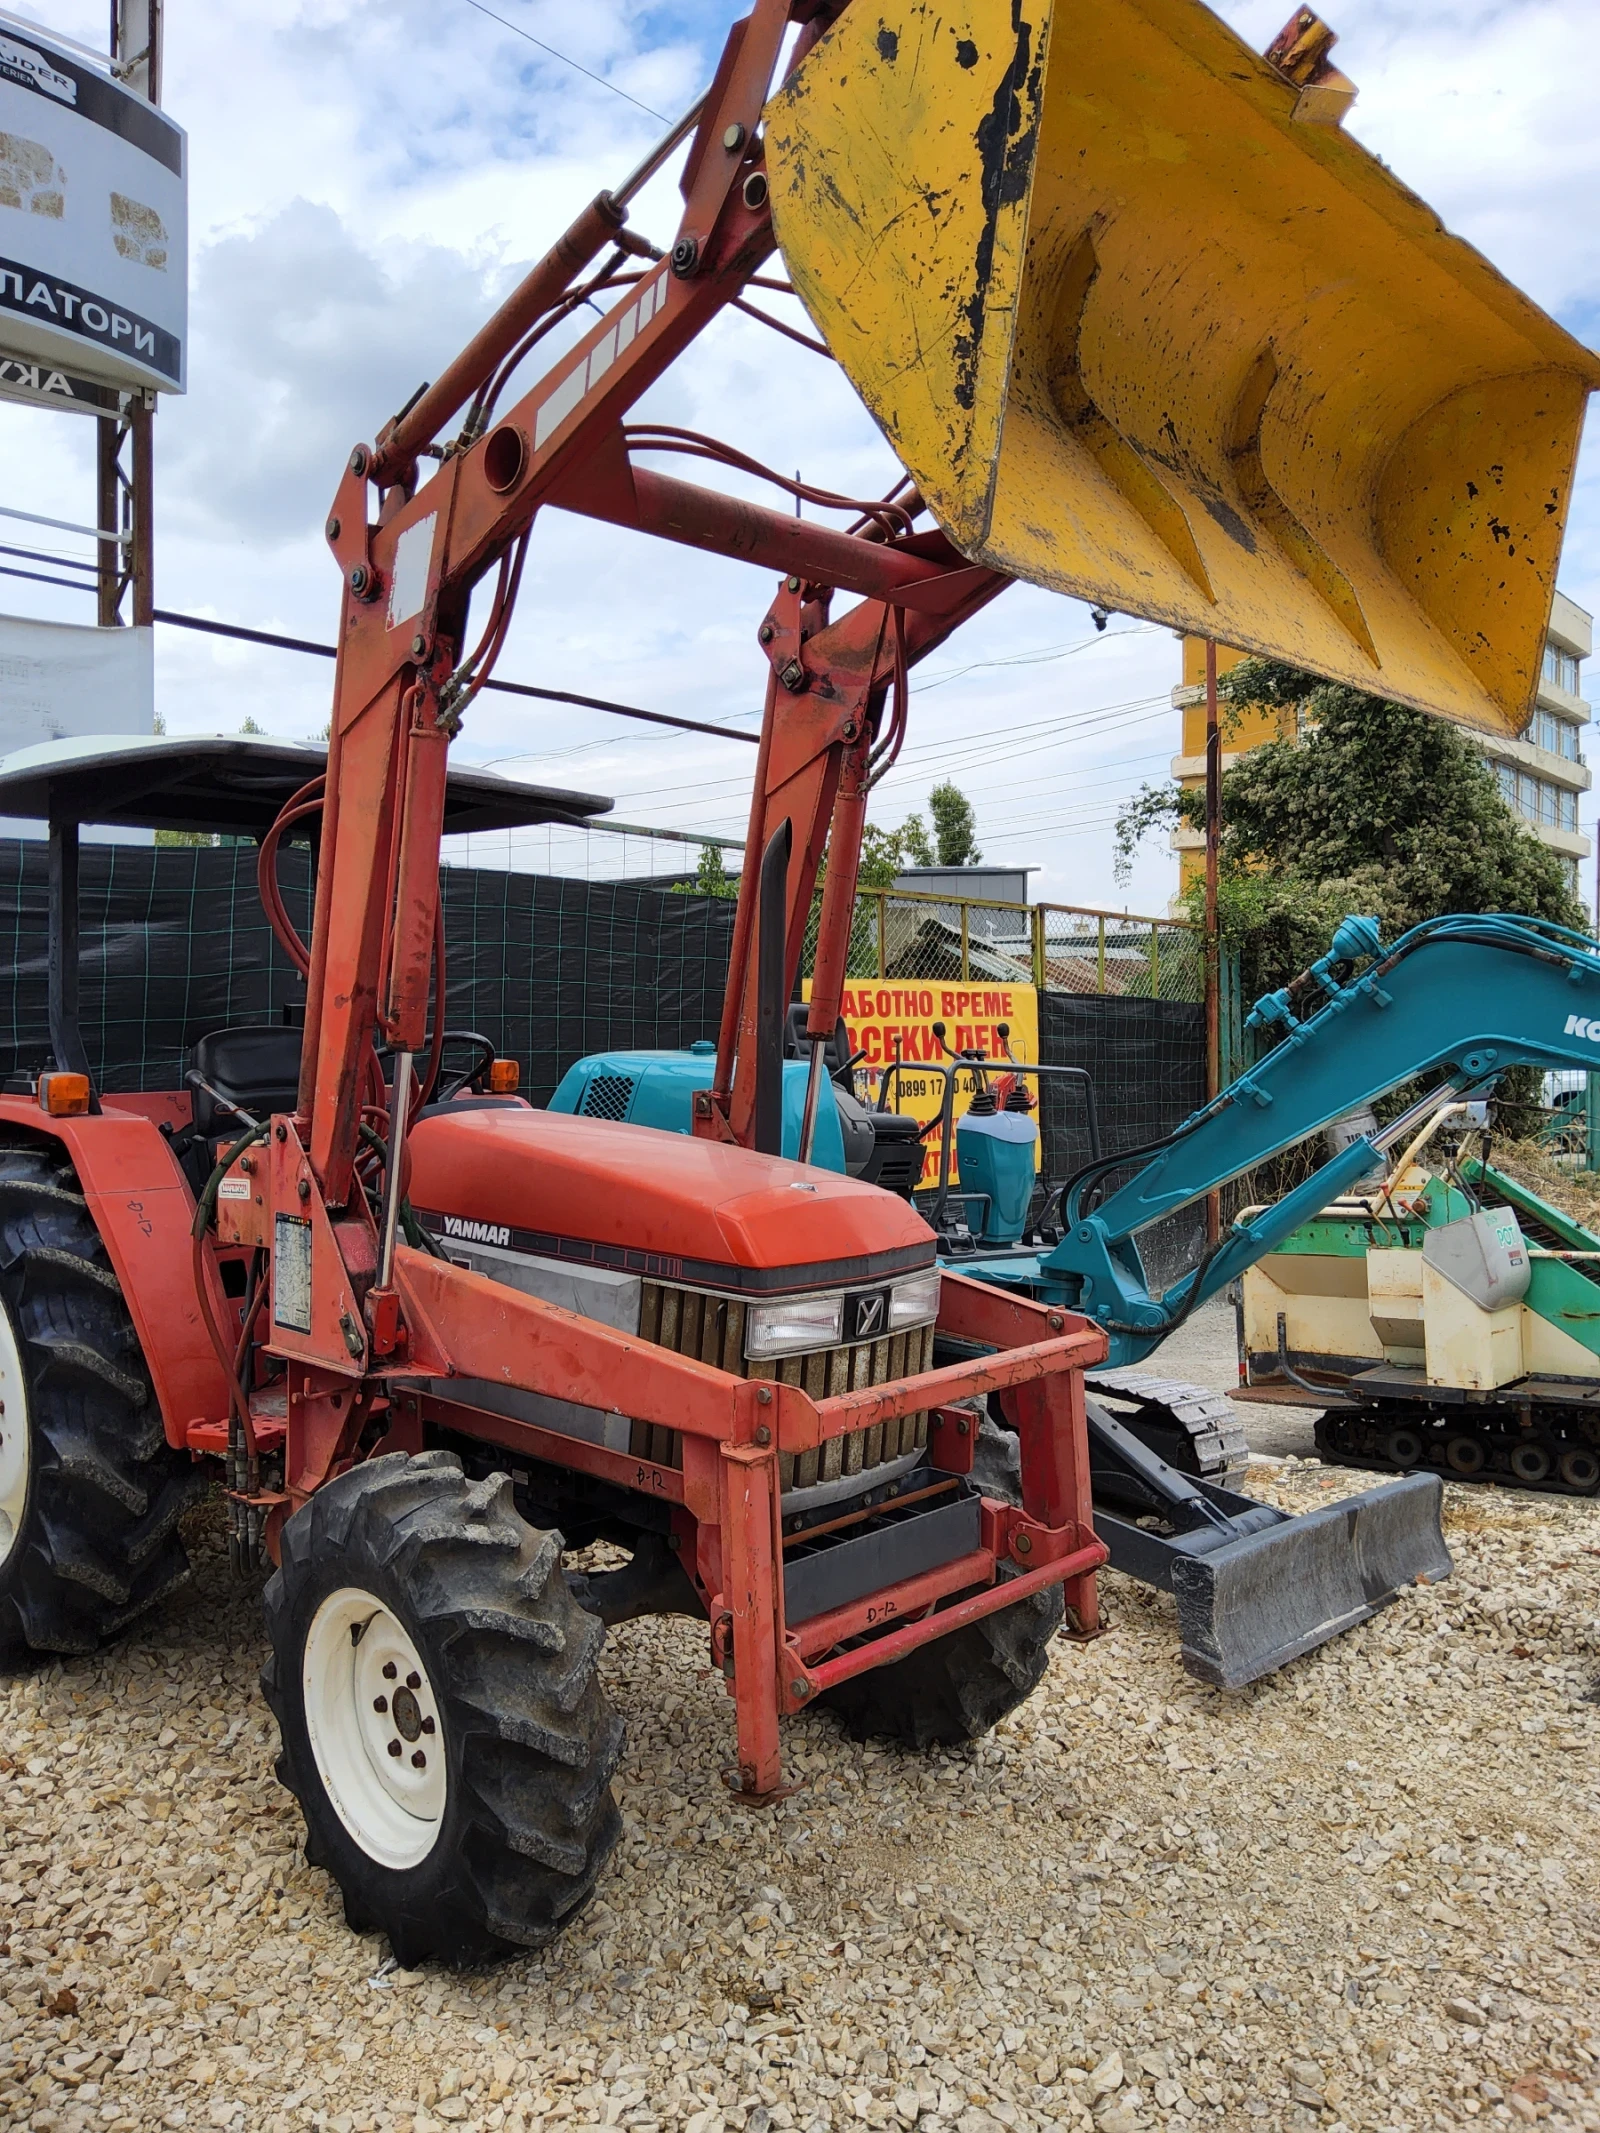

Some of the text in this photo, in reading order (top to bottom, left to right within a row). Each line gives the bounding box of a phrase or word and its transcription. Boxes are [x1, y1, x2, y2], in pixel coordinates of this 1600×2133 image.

[0, 44, 68, 89] JDER
[841, 990, 1014, 1018] АБОТНО ВРЕМЕ
[899, 1079, 926, 1098] 0899
[444, 1216, 510, 1246] YANMAR
